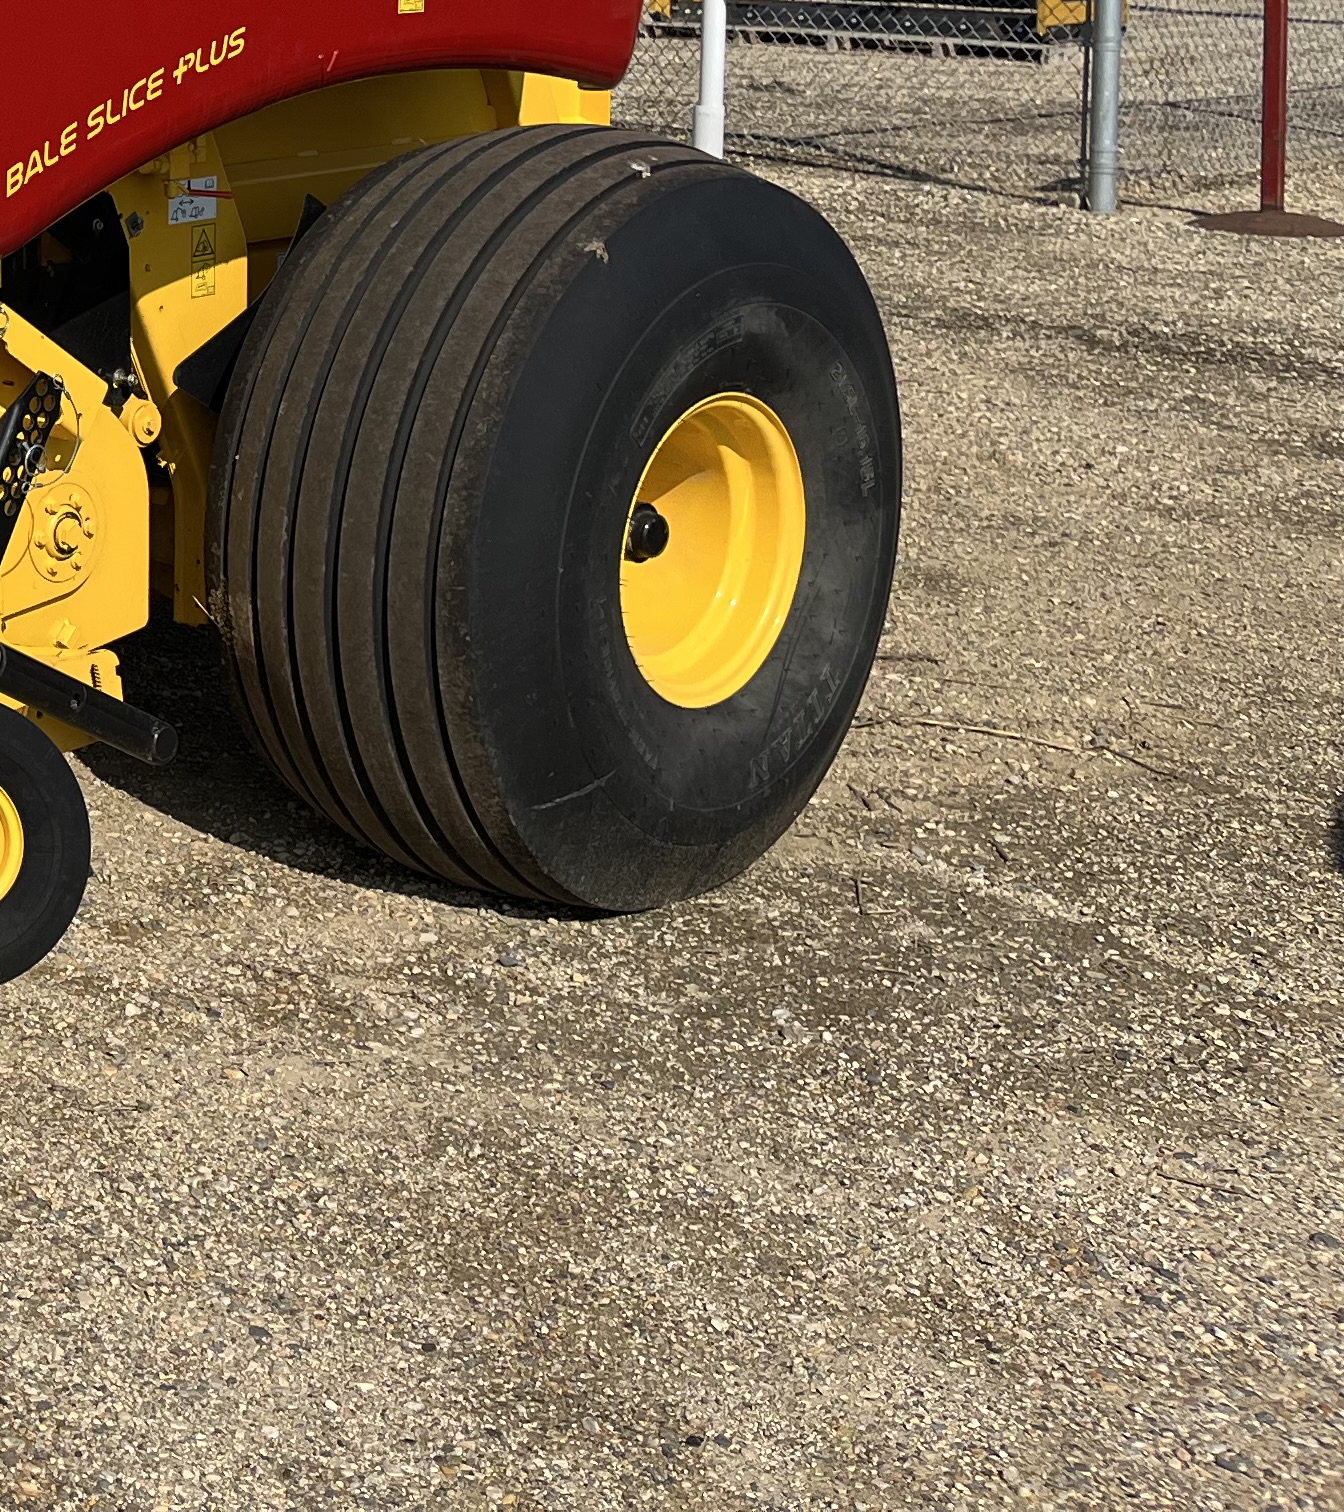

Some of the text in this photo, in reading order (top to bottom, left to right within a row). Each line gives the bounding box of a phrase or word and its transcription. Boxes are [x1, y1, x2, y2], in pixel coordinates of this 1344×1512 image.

[6, 26, 246, 198] BALE SLICE PLUS
